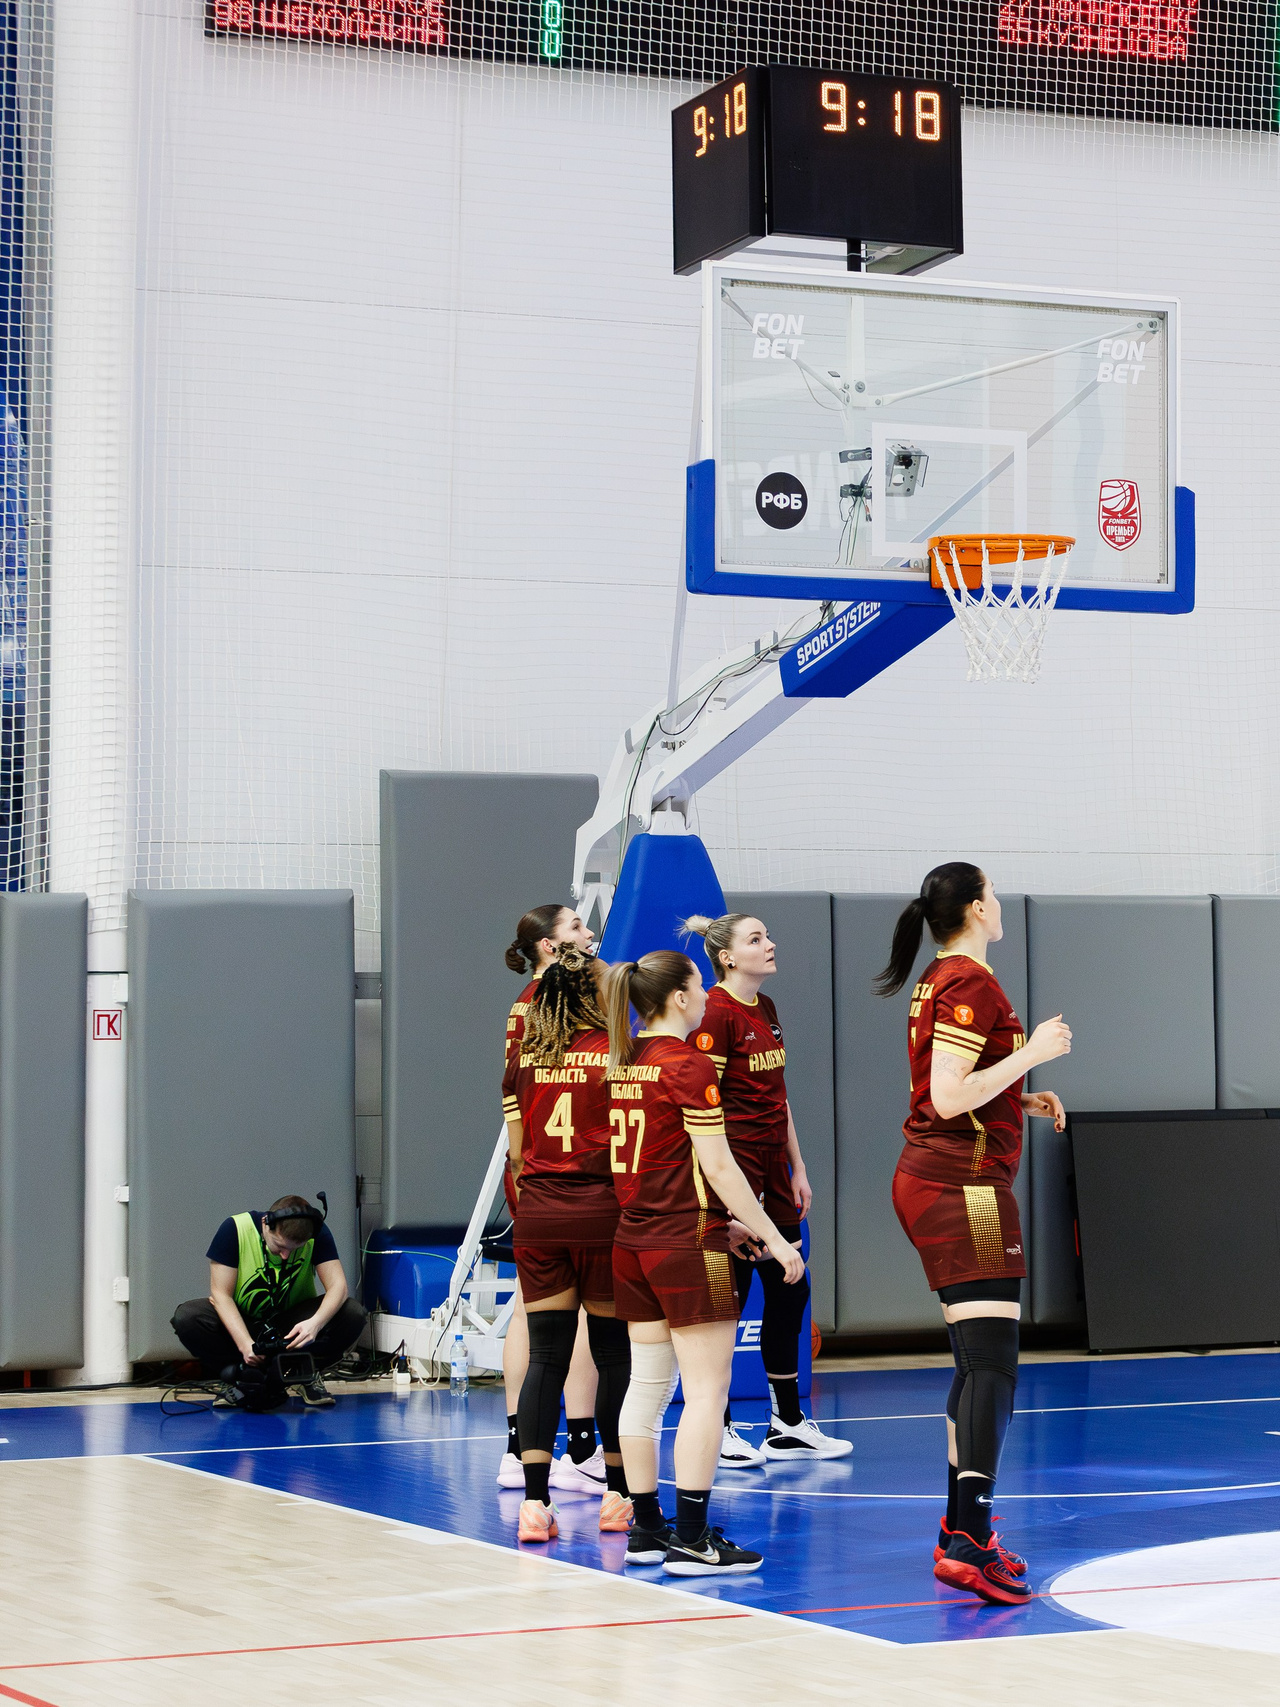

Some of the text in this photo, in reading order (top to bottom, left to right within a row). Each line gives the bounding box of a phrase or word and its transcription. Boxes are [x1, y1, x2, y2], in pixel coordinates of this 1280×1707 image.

[693, 82, 747, 158] 9:18
[820, 81, 941, 141] 9:18
[752, 312, 805, 337] FON
[752, 338, 805, 360] BET
[1097, 338, 1146, 362] FON
[1096, 362, 1146, 385] BET
[761, 491, 803, 510] РФБ
[1106, 525, 1135, 537] ПРЕМЬЕР
[96, 1013, 119, 1036] ПК
[534, 1068, 588, 1084] ОБЛАСТЬ
[611, 1083, 643, 1100] ОБЛАСТЬ
[544, 1092, 575, 1153] 4
[610, 1109, 646, 1174] 27
